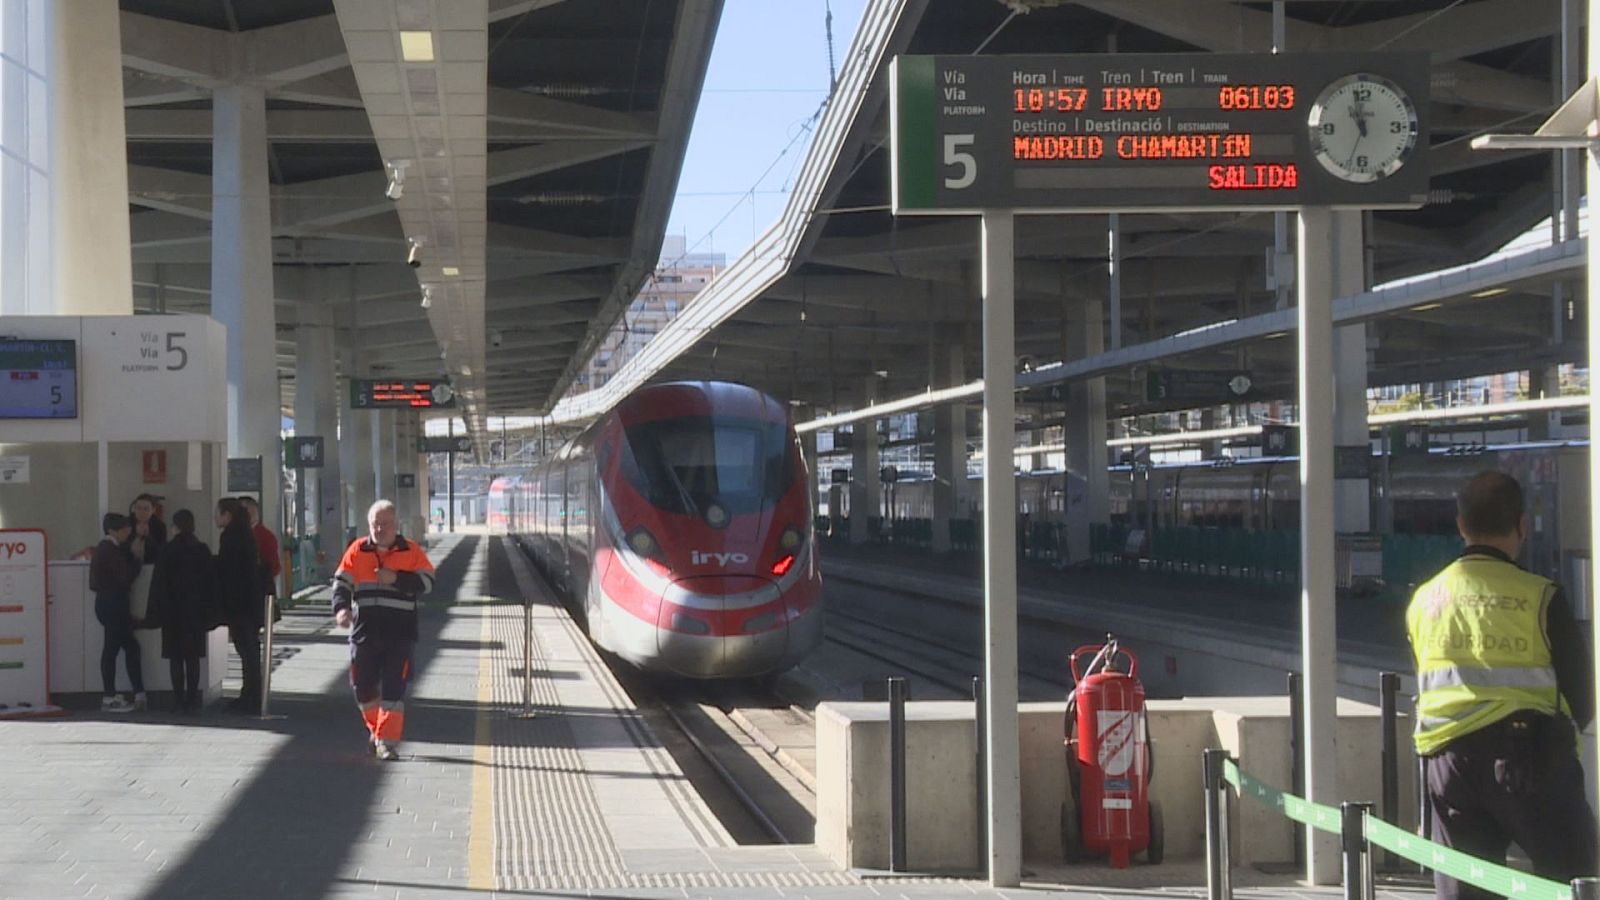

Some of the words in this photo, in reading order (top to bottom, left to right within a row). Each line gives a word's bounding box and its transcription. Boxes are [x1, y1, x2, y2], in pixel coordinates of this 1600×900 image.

[943, 70, 966, 84] Vía
[1013, 71, 1047, 84] Hora
[1063, 75, 1085, 84] TIME
[1101, 71, 1131, 84] Tren
[1152, 71, 1184, 84] Tren
[1203, 74, 1229, 83] TRAIN
[943, 86, 967, 101] Via
[1014, 88, 1089, 111] 10:57
[1101, 87, 1162, 111] IRYO
[1219, 86, 1296, 110] 06103
[1353, 89, 1372, 102] 12
[943, 105, 986, 116] PLATFORM
[1013, 119, 1067, 132] Destino
[1085, 117, 1162, 132] Destinació
[1177, 122, 1230, 132] DESTINATION
[1323, 122, 1335, 136] 9
[1390, 122, 1402, 134] 3
[1013, 134, 1104, 159] MADRID
[943, 134, 977, 188] 5
[1356, 155, 1369, 168] 6
[1208, 164, 1298, 189] SALIDA
[166, 332, 187, 371] 5
[50, 385, 62, 405] 5
[691, 551, 748, 567] iryo
